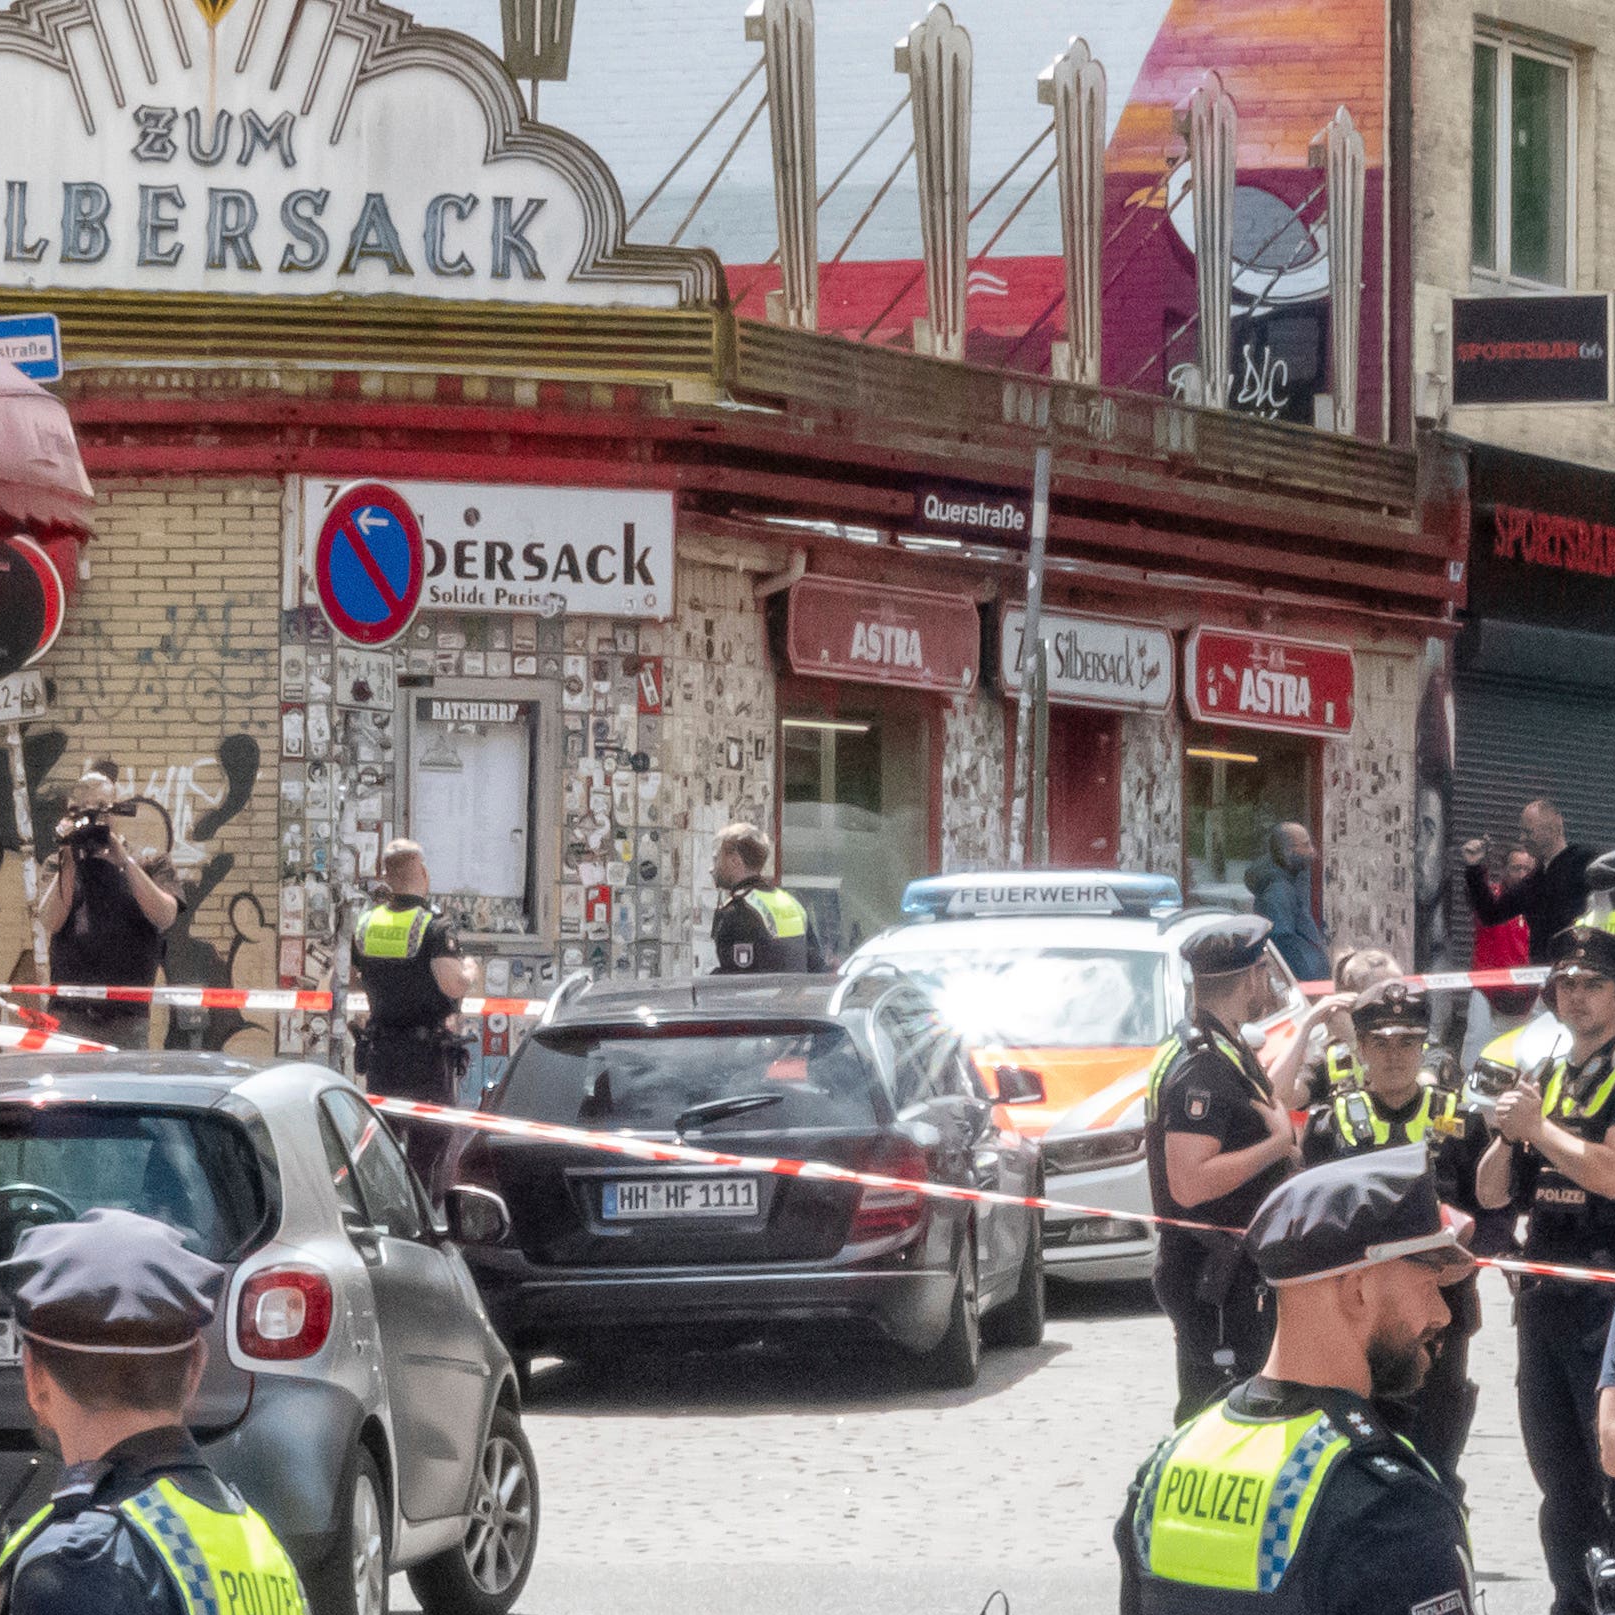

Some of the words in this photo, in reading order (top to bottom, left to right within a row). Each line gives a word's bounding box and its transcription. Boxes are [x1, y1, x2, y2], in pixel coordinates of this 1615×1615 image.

[131, 104, 296, 167] ZUM
[924, 494, 1025, 531] Querstraße
[850, 621, 923, 669] ASTRA
[1239, 667, 1312, 719] ASTRA
[961, 886, 1109, 904] FEUERWEHR
[620, 1186, 648, 1210] HH
[666, 1184, 693, 1208] HF
[699, 1183, 755, 1208] 1111
[1163, 1465, 1265, 1527] POLIZEI
